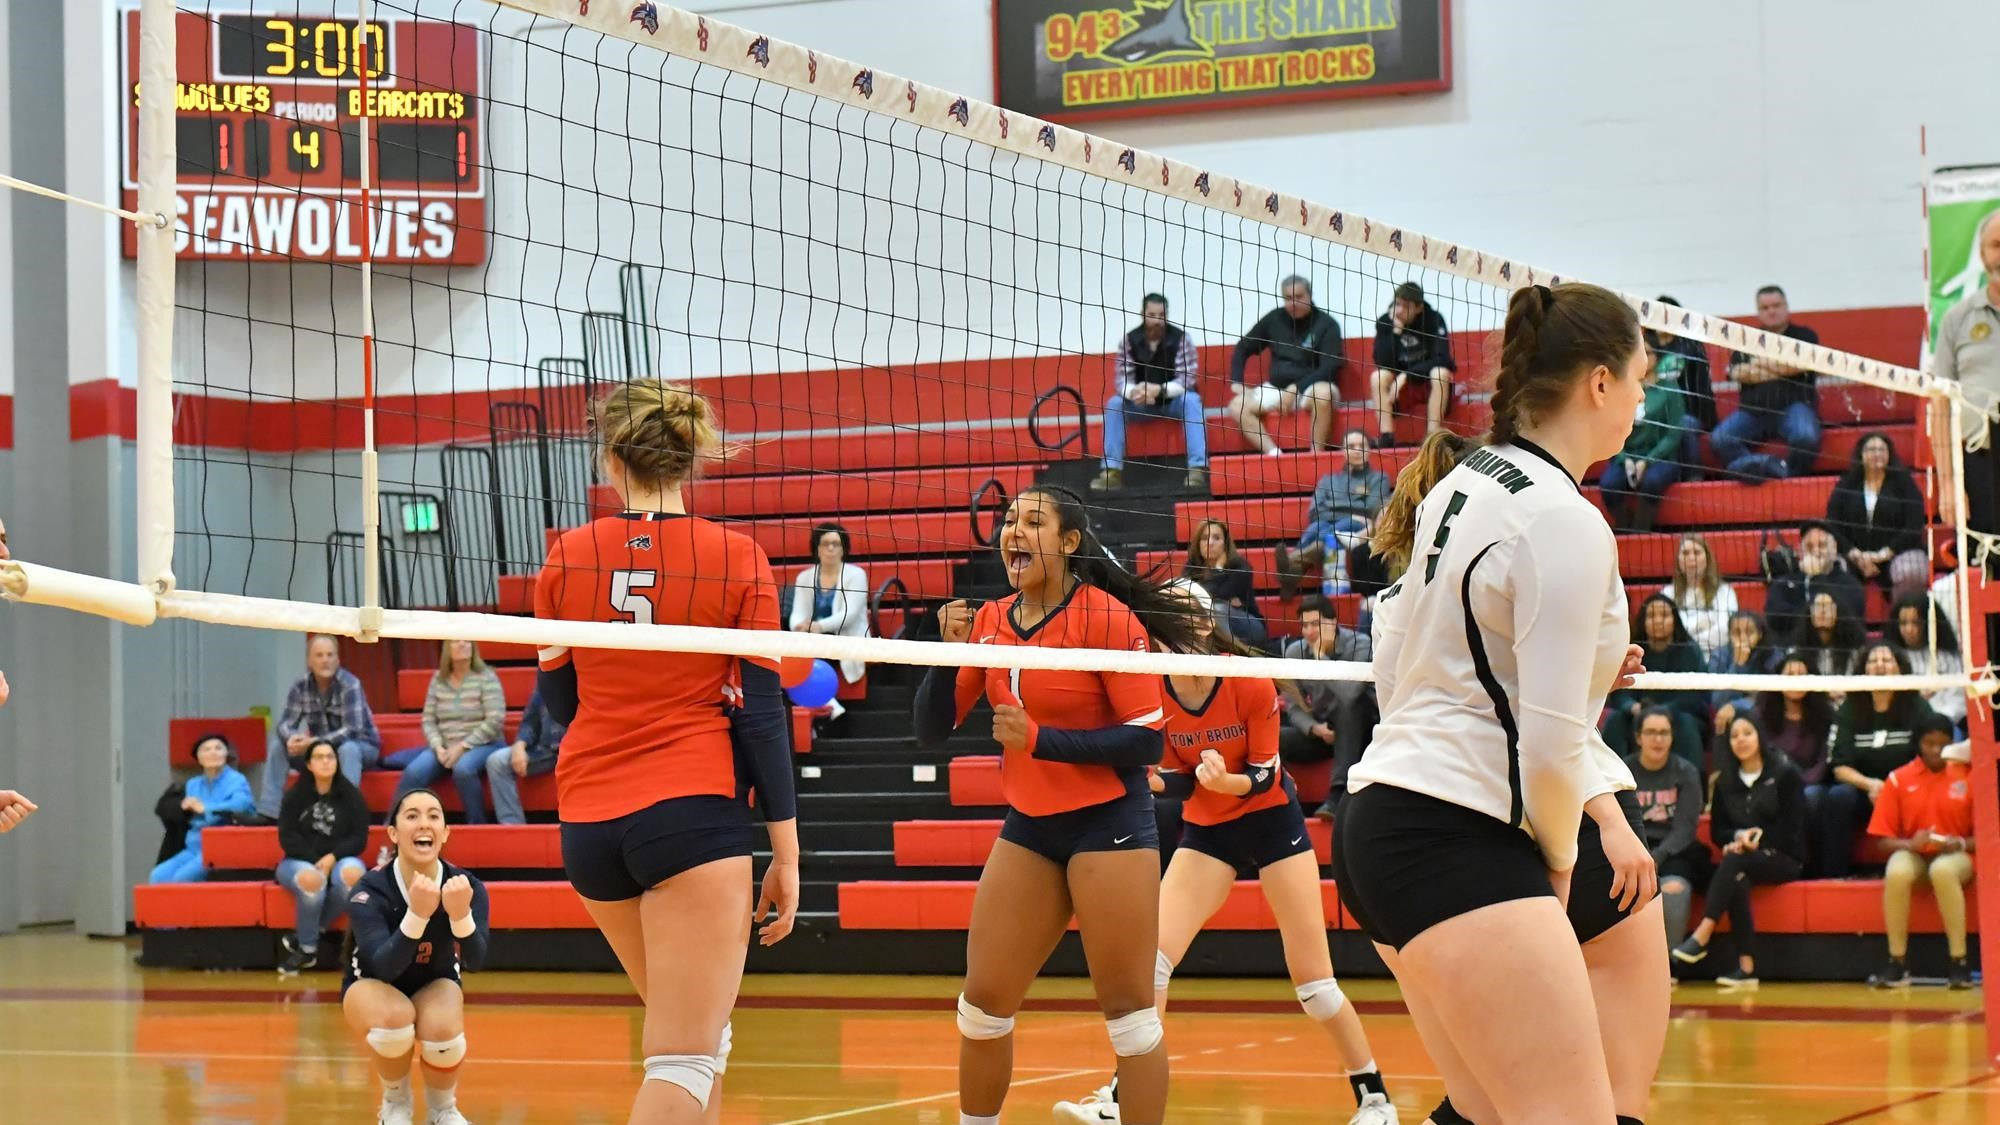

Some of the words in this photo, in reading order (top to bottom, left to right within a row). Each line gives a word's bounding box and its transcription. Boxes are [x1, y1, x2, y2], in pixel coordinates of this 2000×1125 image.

[1195, 0, 1266, 45] THE
[266, 19, 384, 79] 3:00
[134, 82, 271, 112] WOLVES
[1063, 59, 1215, 105] EVERYTHING
[1216, 53, 1281, 92] THAT
[1283, 44, 1375, 86] ROCKS
[274, 101, 337, 122] PERIOD
[348, 89, 465, 119] BEARCATS
[219, 123, 229, 171] 1
[292, 130, 320, 169] 4
[457, 130, 467, 178] 1
[1425, 490, 1468, 586] 5
[609, 568, 657, 624] 5
[415, 941, 433, 965] 2
